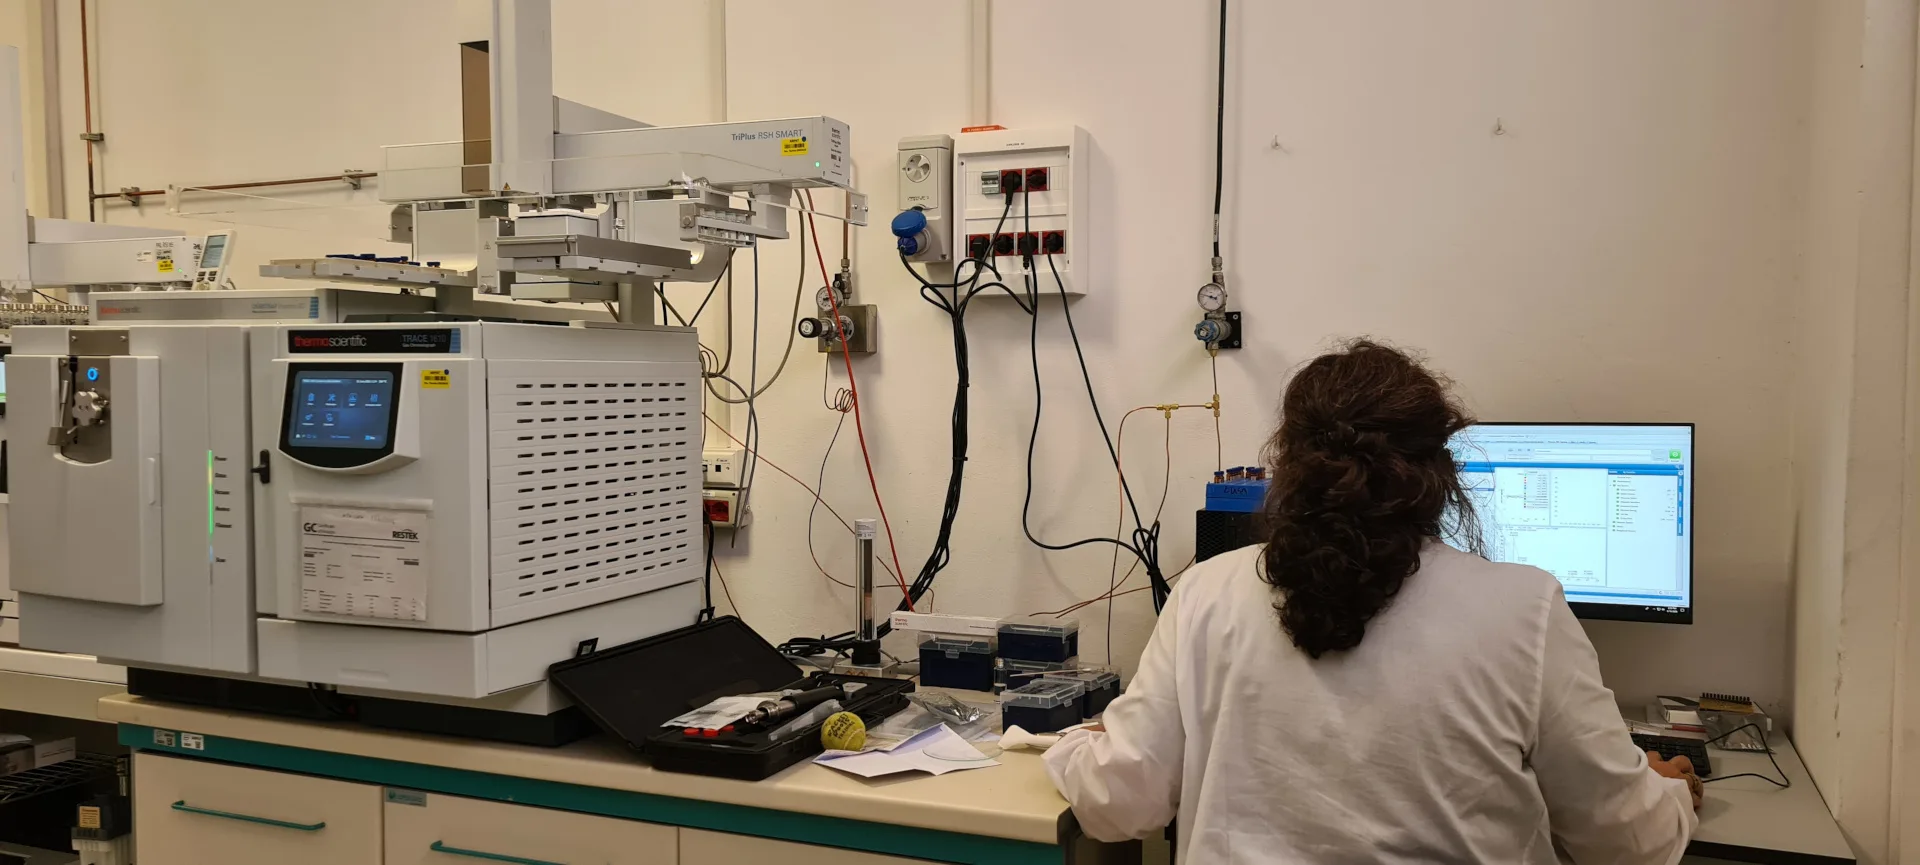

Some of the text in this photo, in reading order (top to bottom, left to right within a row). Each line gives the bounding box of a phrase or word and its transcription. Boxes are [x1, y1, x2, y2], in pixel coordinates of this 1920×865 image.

[731, 129, 803, 141] TriPlus RSH SMART
[402, 334, 428, 343] TRACE
[303, 522, 318, 533] GC
[392, 530, 419, 540] RESTEK
